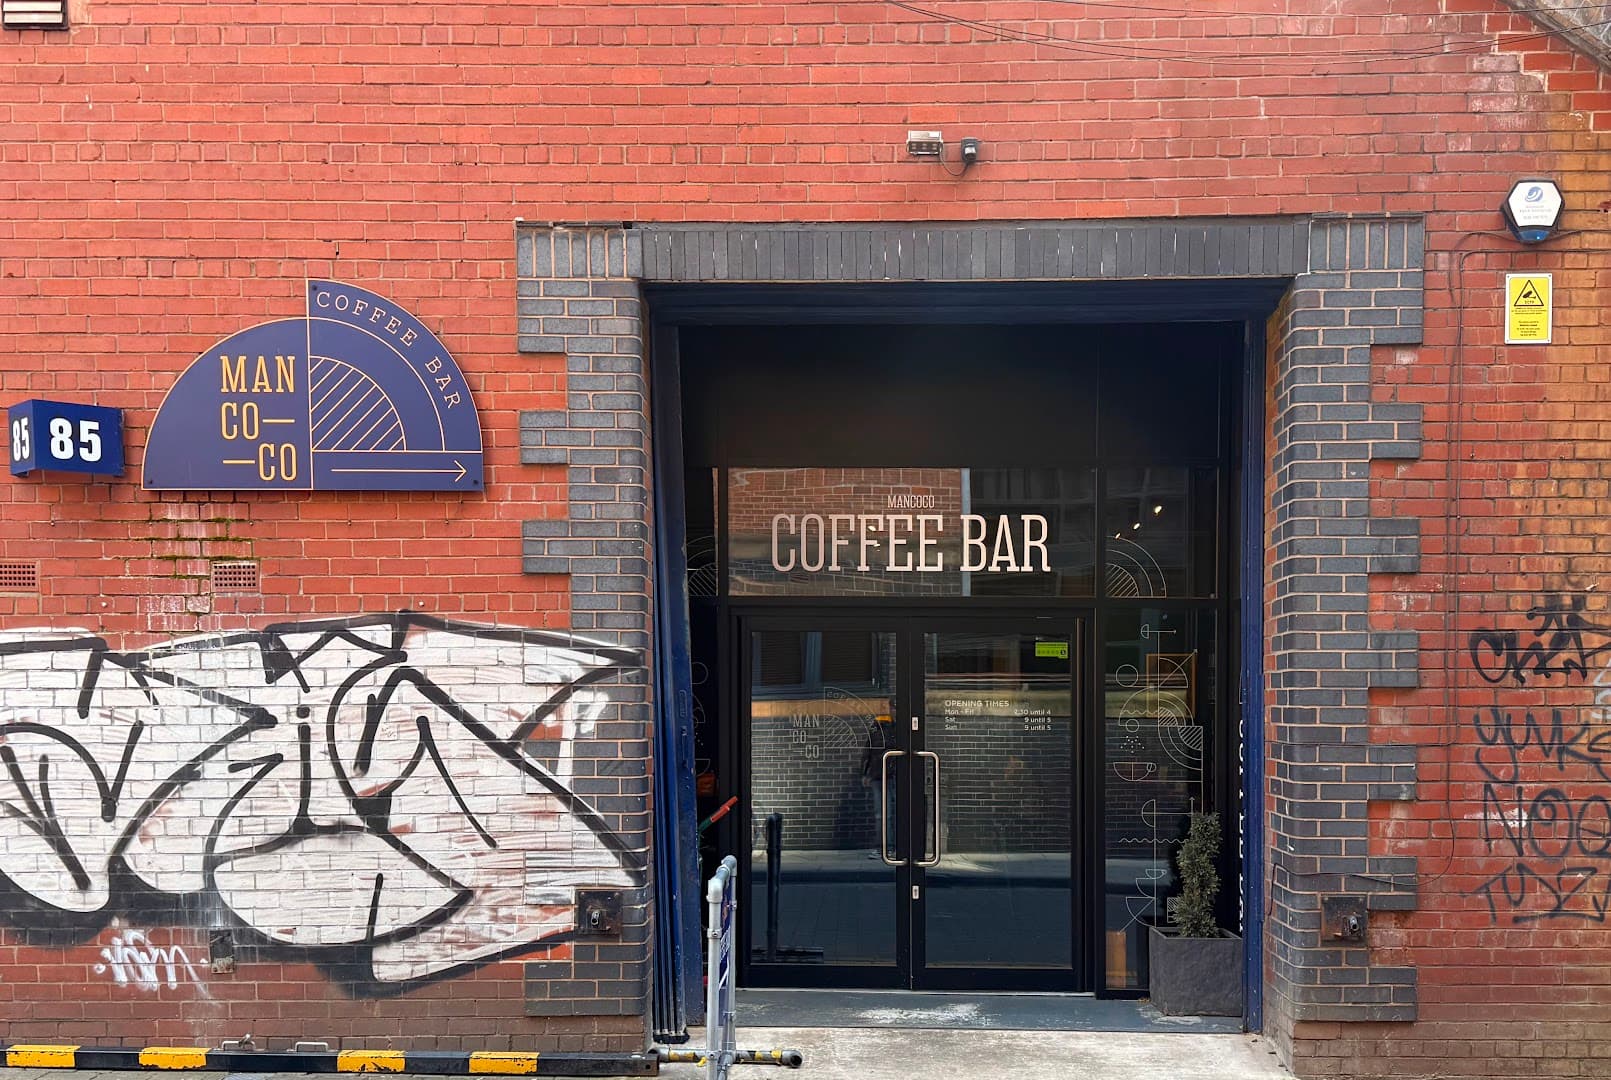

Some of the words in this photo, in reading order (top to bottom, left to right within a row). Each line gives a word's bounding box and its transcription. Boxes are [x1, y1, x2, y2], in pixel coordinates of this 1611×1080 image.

[316, 291, 418, 347] COFFEE
[425, 357, 461, 409] BAR
[220, 356, 296, 393] MAN
[12, 418, 31, 462] 85
[49, 417, 101, 462] 85
[887, 495, 935, 509] MANCOCO
[771, 513, 944, 573] COFFEE
[960, 513, 1051, 573] BAR
[793, 714, 820, 728] MAN
[944, 699, 983, 707] OPENING
[984, 699, 1010, 707] TIMES
